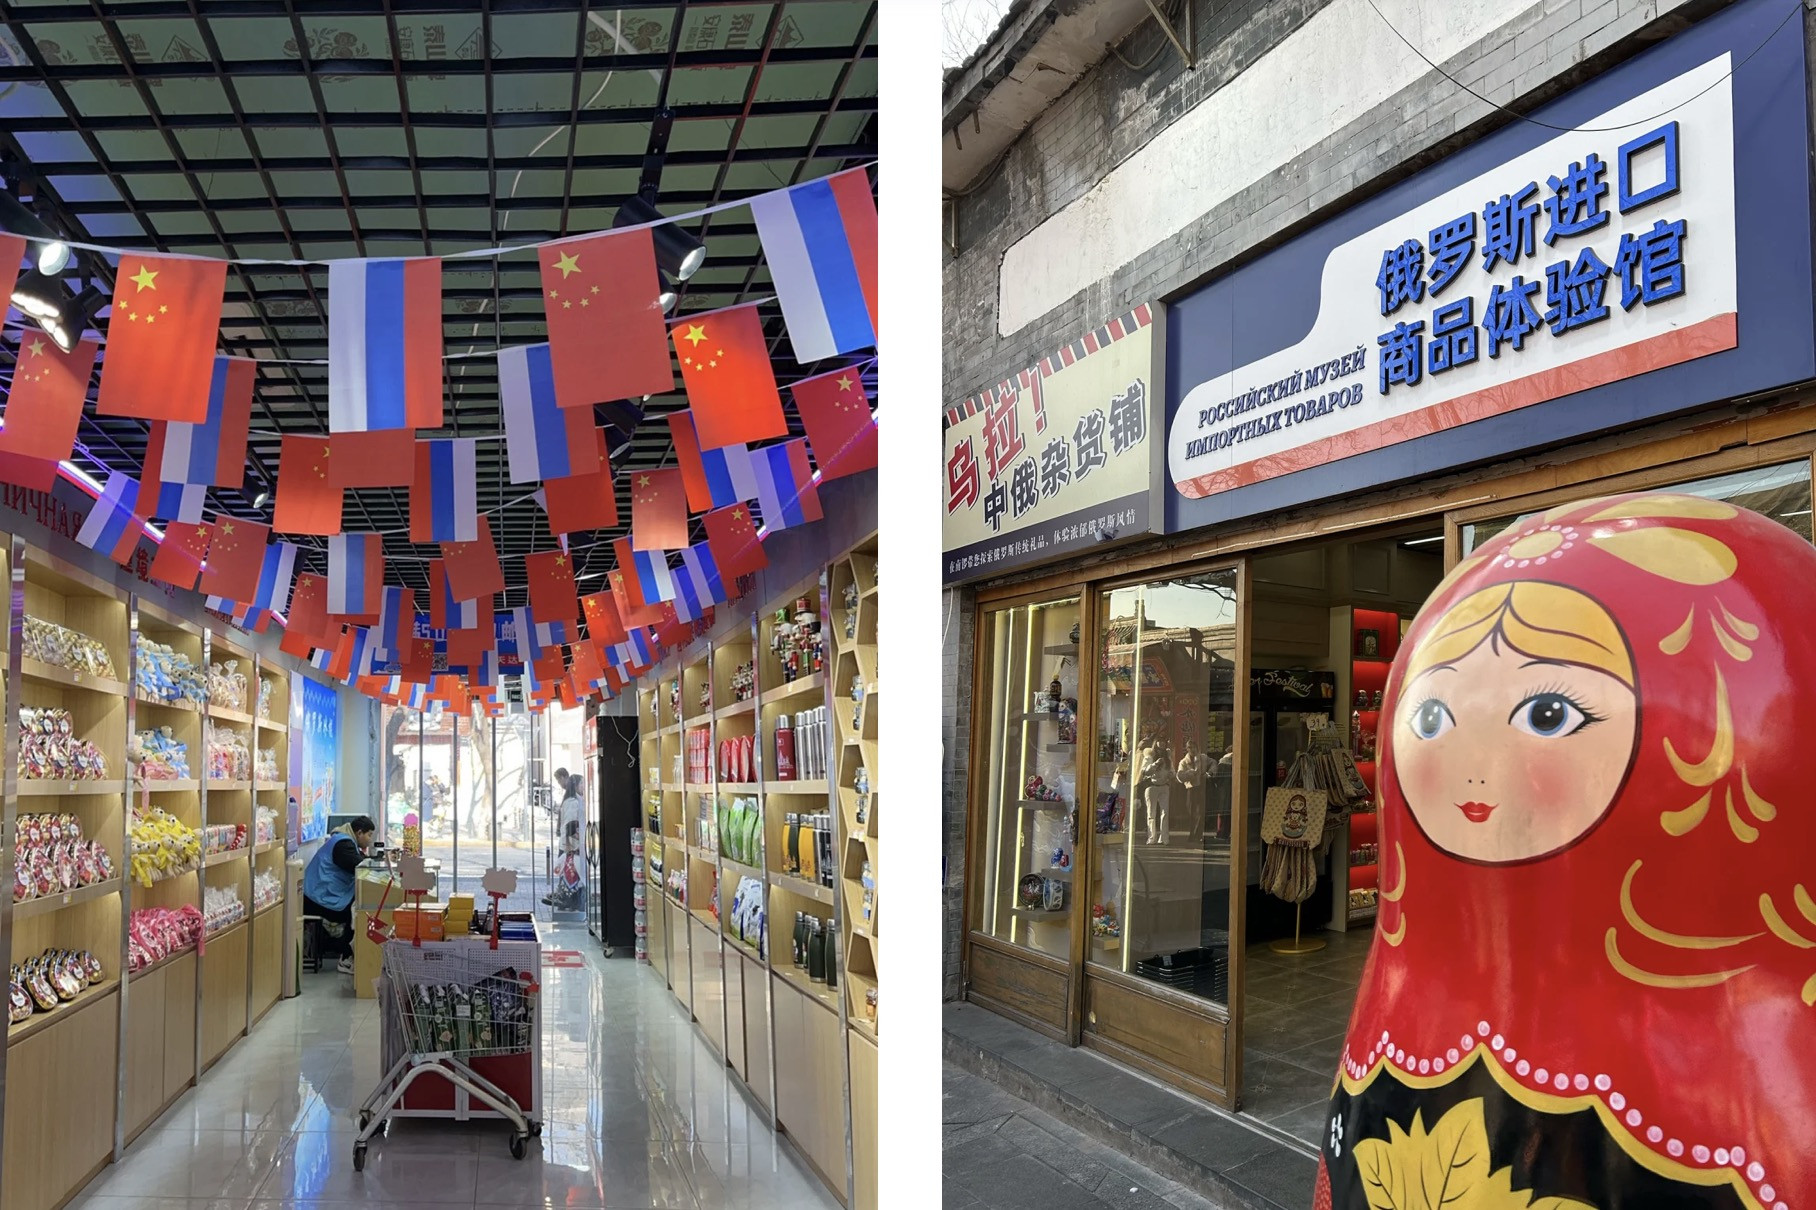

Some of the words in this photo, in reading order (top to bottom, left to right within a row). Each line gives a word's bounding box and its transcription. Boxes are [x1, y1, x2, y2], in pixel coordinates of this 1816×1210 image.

[1375, 120, 1681, 317] 俄罗斯进口
[1377, 219, 1688, 395] 商品体验馆
[983, 378, 1146, 533] 中俄杂货铺
[1185, 409, 1284, 459] ИМПОРТНЫХ
[1284, 382, 1363, 427] ТОВАРОВ
[1198, 368, 1303, 428] РОССИЙСКИЙ
[1304, 343, 1367, 390] МУЗЕЙ
